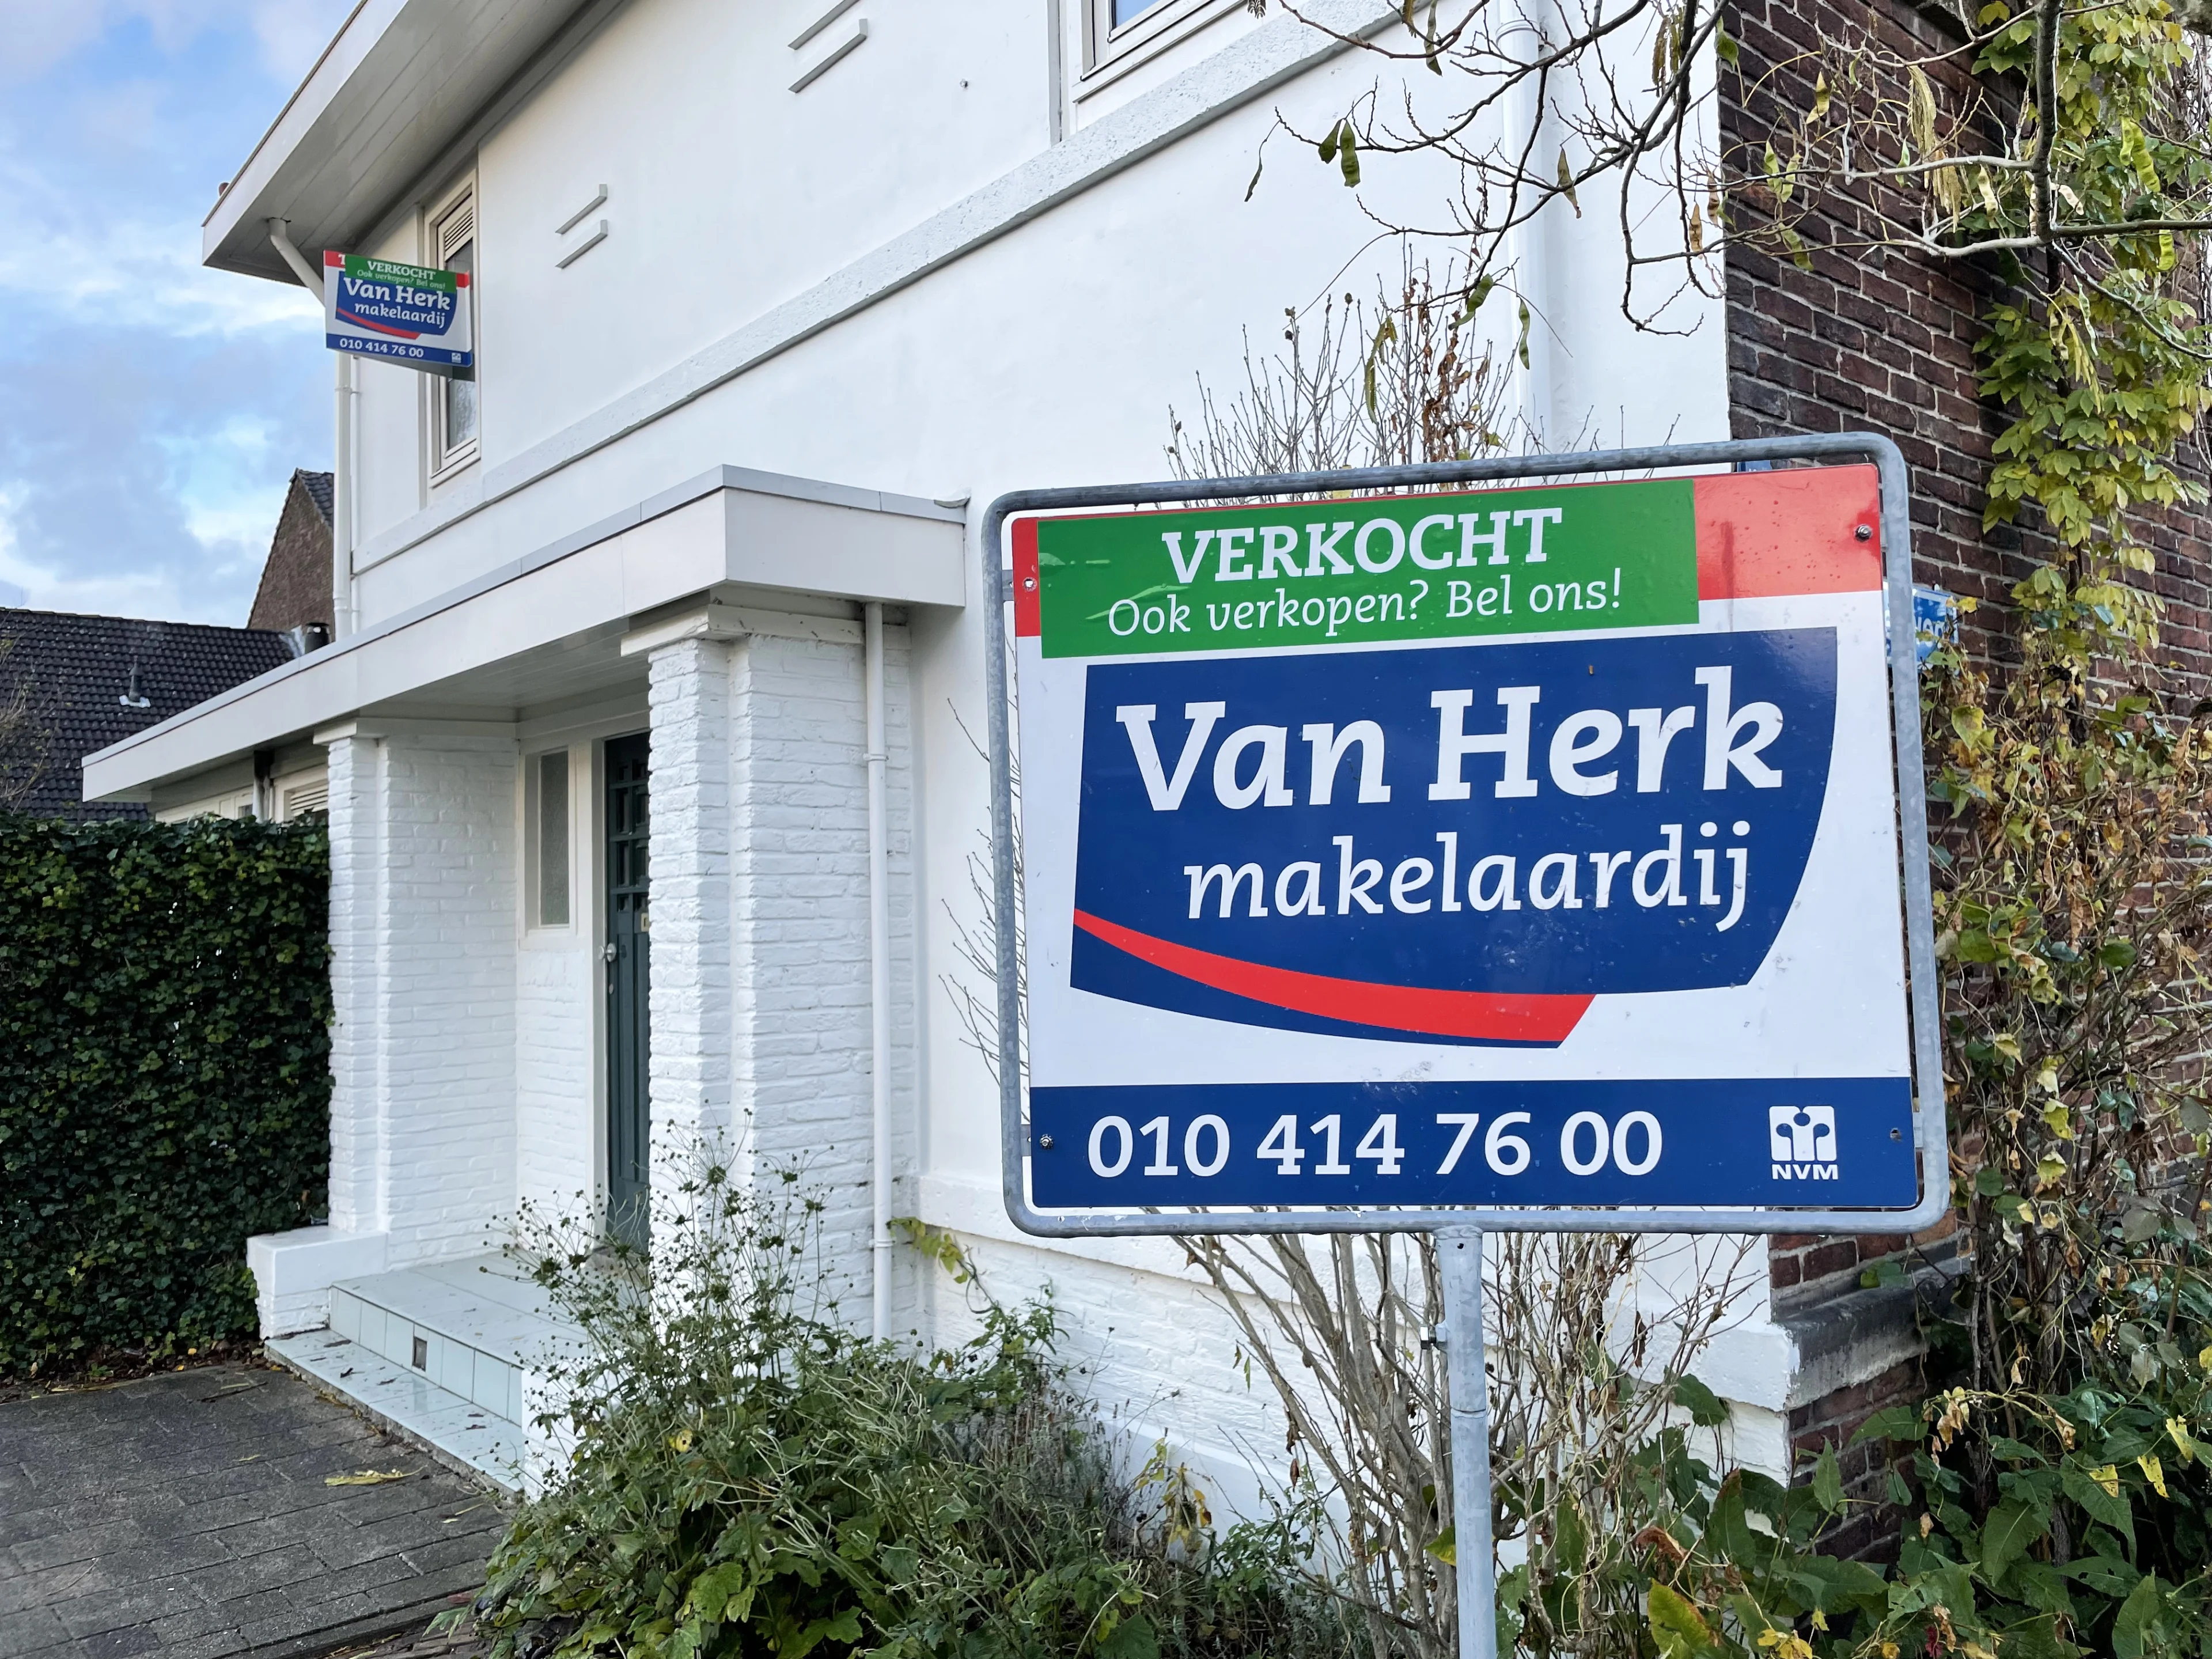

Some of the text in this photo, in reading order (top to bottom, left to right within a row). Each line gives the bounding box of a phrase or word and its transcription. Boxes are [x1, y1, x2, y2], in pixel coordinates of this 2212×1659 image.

[357, 269, 372, 278] Ook
[376, 273, 415, 284] verkopen?
[416, 278, 428, 287] Bel
[367, 260, 436, 280] VERKOCHT
[343, 276, 450, 310] Van Herk
[355, 303, 445, 329] makelaardij
[340, 338, 424, 358] 010 414 76 00
[1161, 507, 1563, 584] VERKOCHT
[1108, 567, 1621, 638] Ook verkopen? Bel ons!
[1115, 665, 1783, 812] Van Herk
[1183, 820, 1751, 933] makelaardij
[1088, 1110, 1663, 1178] 010 414 76 00
[1771, 1164, 1839, 1180] NVM
